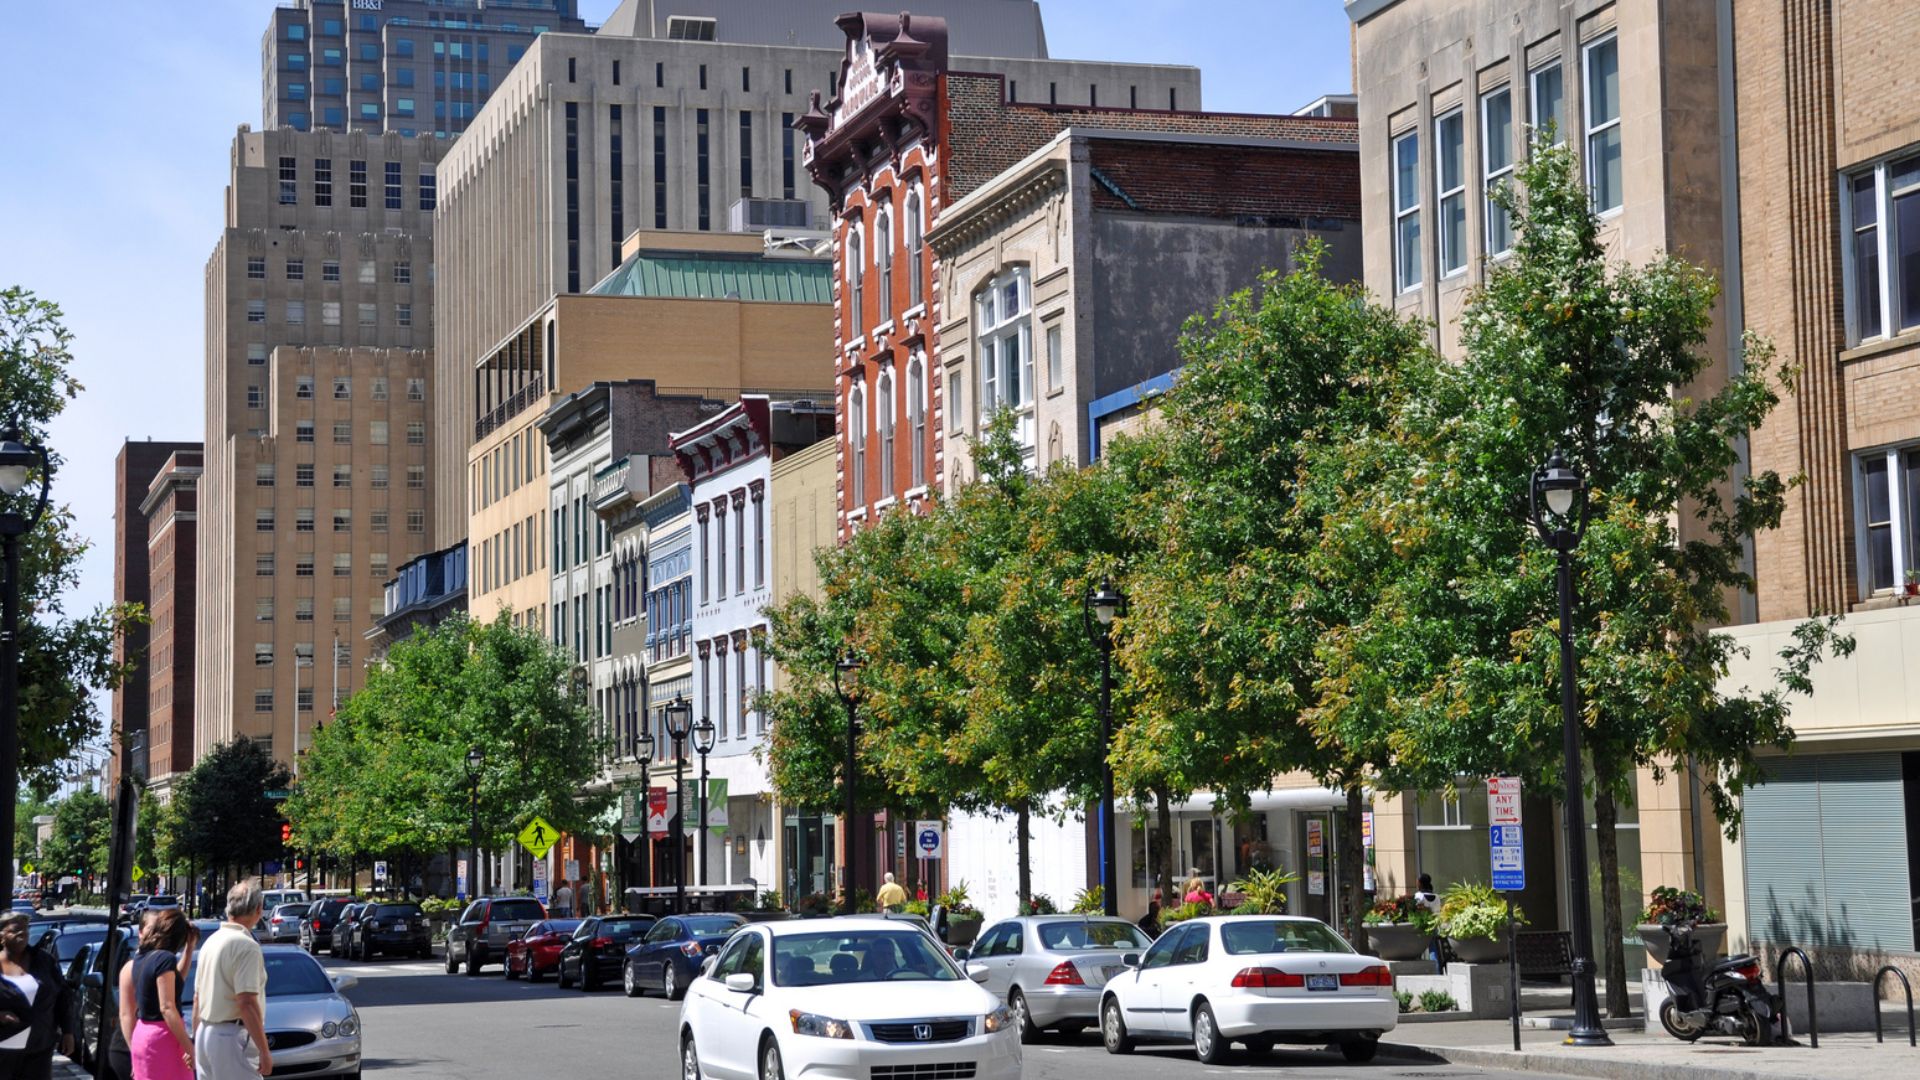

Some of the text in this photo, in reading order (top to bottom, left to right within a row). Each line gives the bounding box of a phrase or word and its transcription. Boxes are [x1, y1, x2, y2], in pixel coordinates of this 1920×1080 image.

[353, 0, 384, 10] BB&T
[1496, 795, 1512, 803] ANY
[1496, 807, 1514, 815] TIME
[1493, 830, 1499, 843] 2
